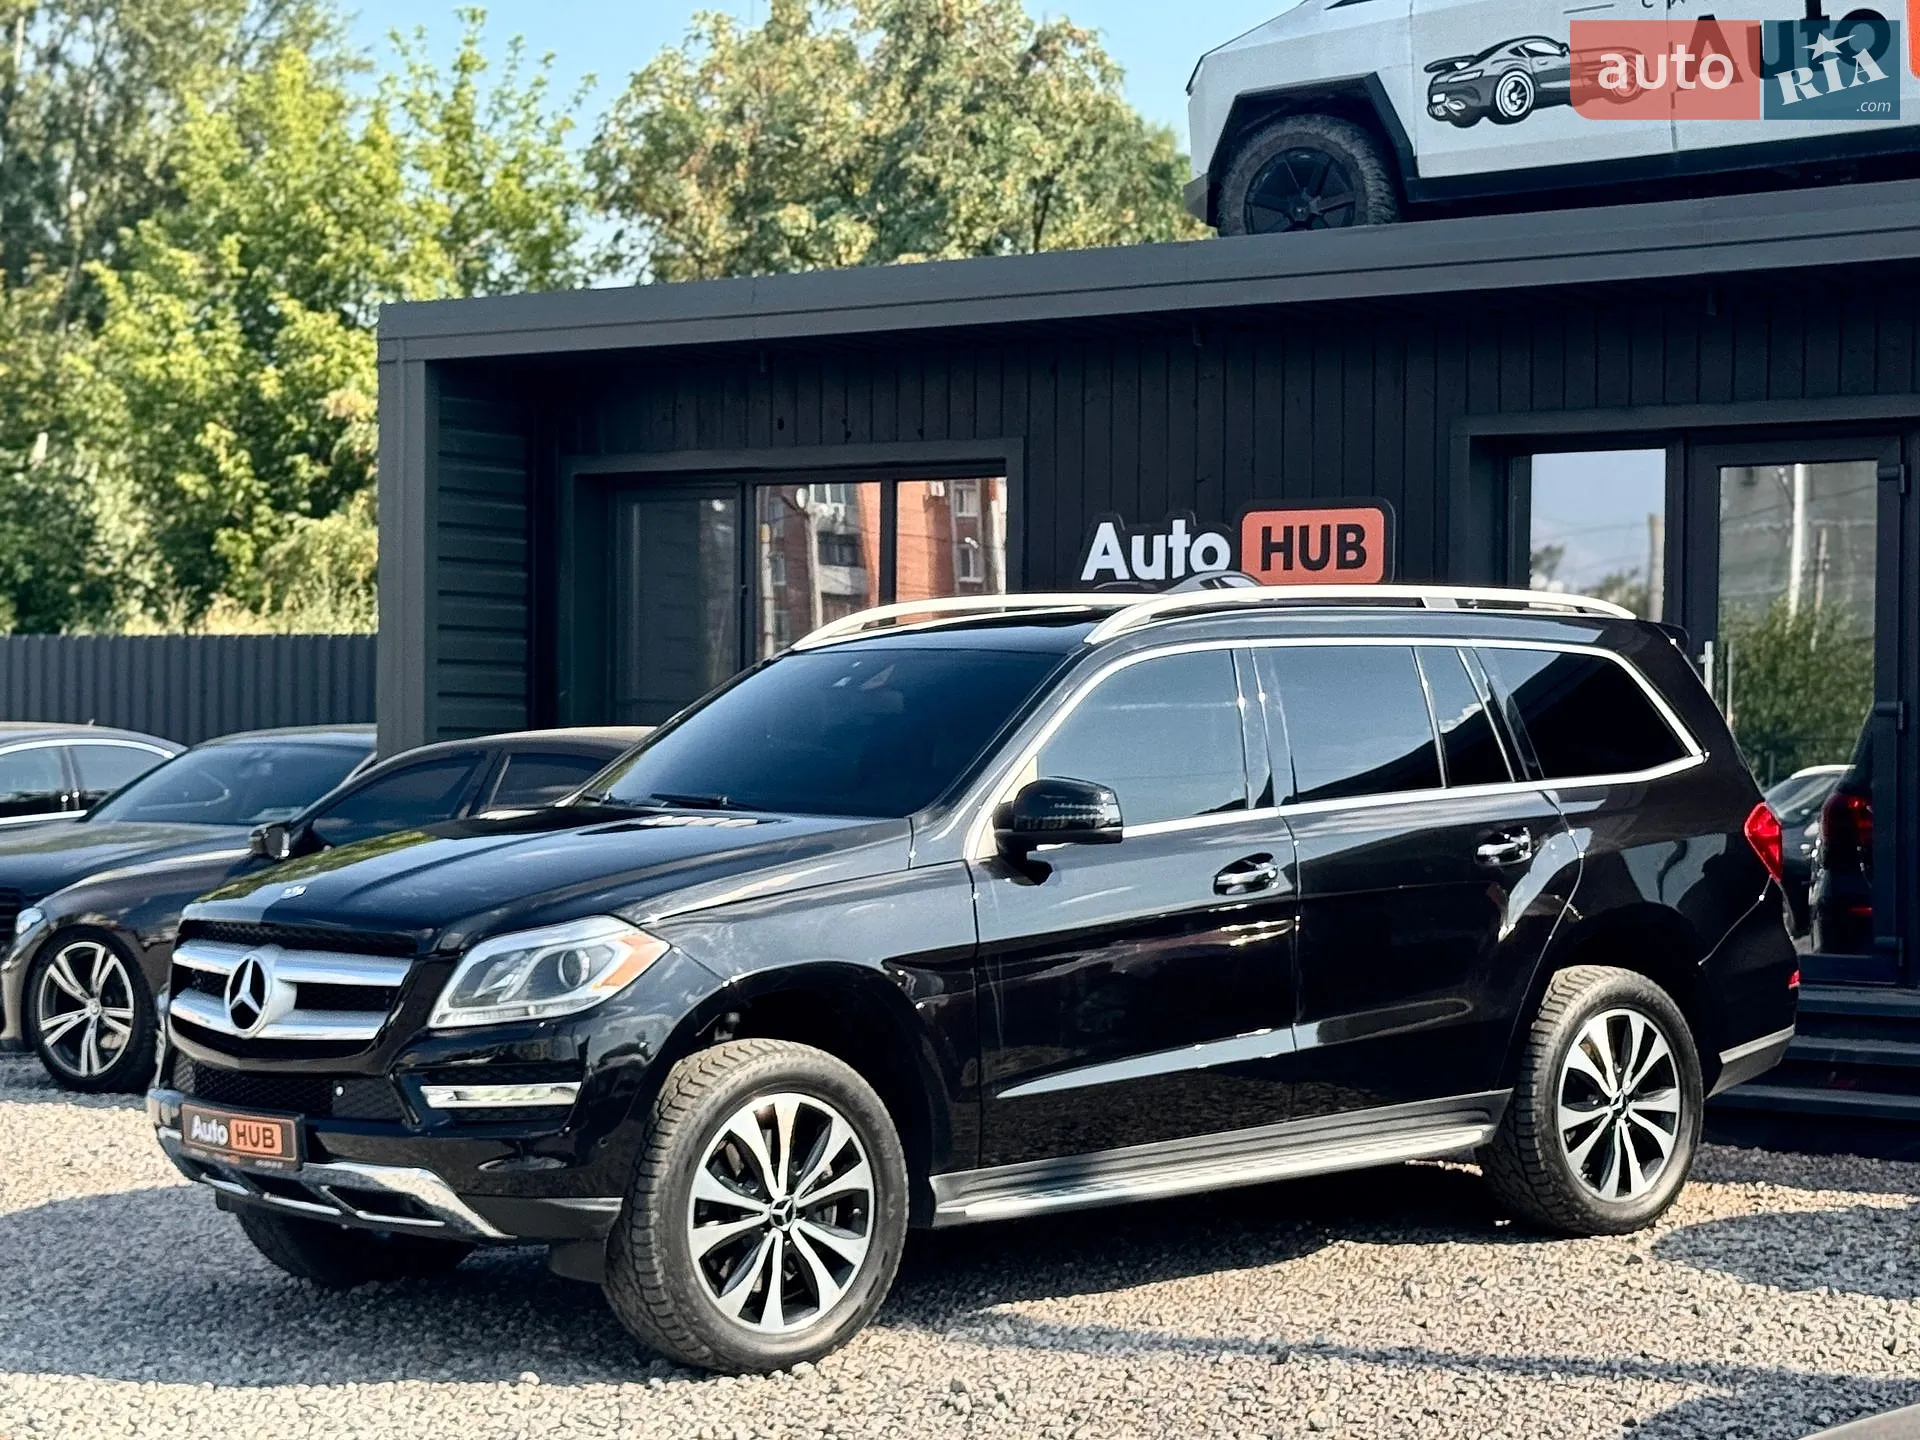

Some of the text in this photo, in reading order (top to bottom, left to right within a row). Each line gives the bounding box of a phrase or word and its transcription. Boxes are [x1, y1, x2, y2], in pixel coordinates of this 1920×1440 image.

[1684, 0, 1891, 84] Auto
[1081, 519, 1367, 580] Auto HUB
[191, 1115, 275, 1148] Auto HUB
